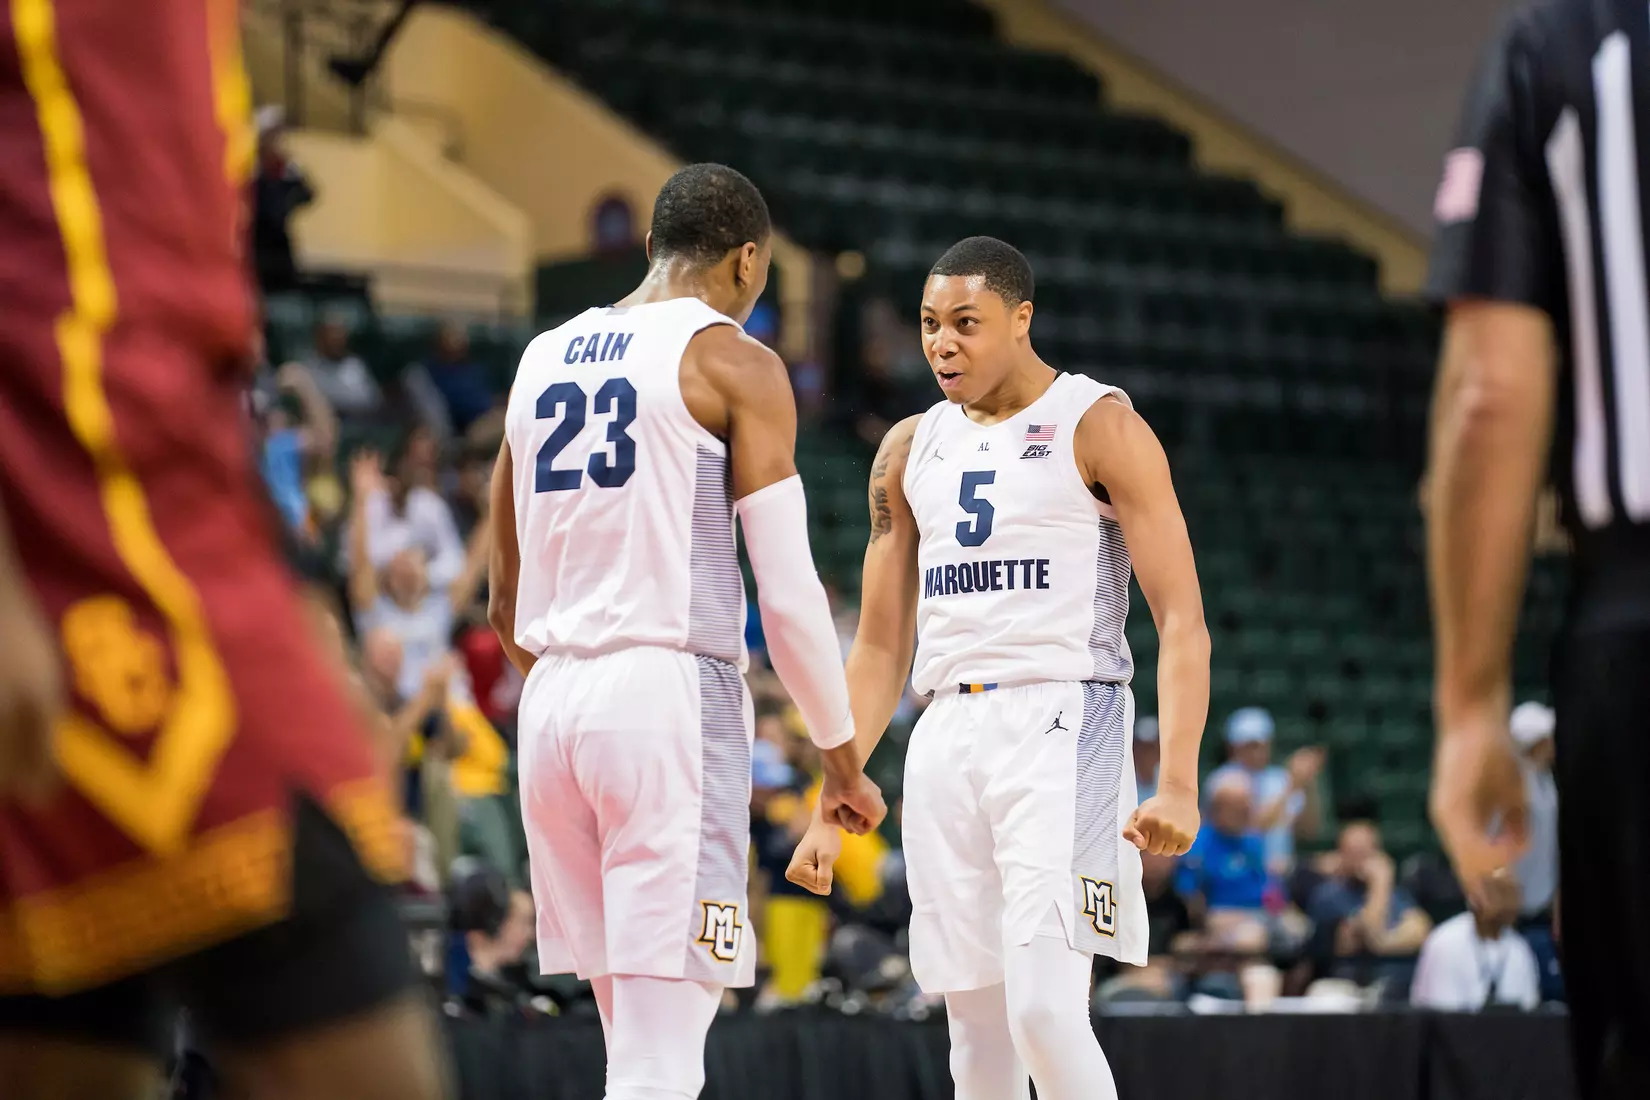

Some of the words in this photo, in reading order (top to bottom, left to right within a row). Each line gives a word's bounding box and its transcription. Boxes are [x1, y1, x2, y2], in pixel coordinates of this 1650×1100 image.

[564, 332, 634, 365] CAIN
[535, 377, 637, 493] 23
[977, 442, 990, 452] AL
[955, 470, 996, 547] 5
[924, 558, 1050, 599] MARQUETTE
[696, 900, 742, 963] MU
[1080, 876, 1117, 937] MU
